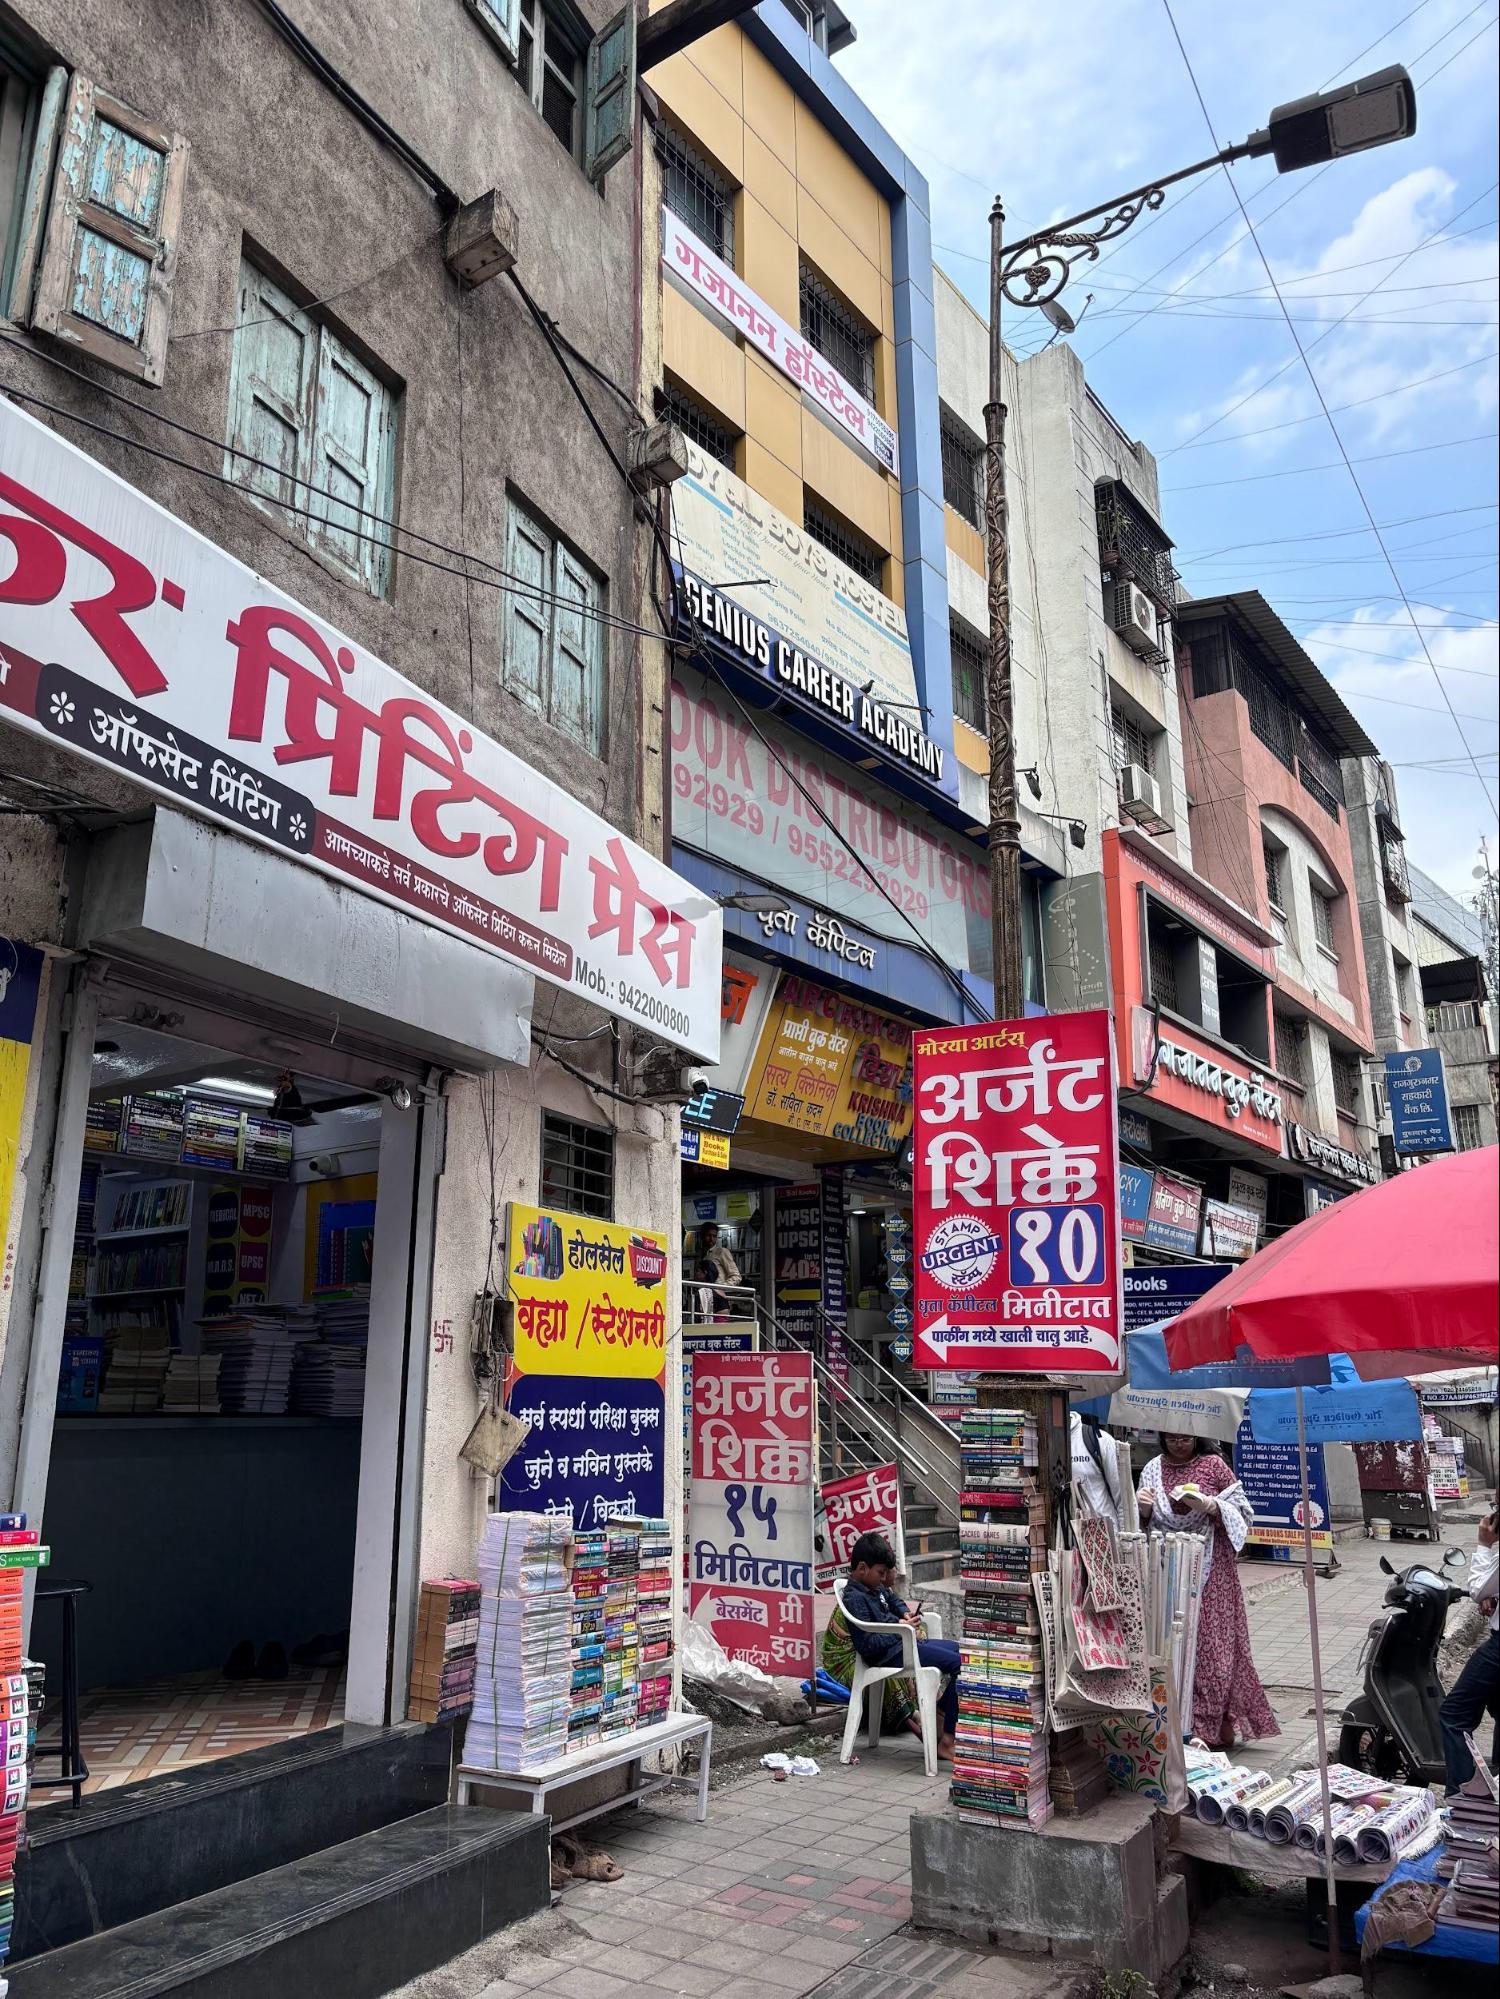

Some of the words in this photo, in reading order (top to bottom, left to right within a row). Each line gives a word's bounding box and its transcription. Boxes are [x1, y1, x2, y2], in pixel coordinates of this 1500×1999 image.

[674, 234, 776, 352] गजानन
[784, 336, 866, 437] हॉस्टेल
[683, 573, 771, 670] GENIUS
[778, 637, 856, 723] CAREER
[861, 695, 945, 780] ACADEMY
[89, 707, 203, 790] ऑफसेट
[209, 758, 282, 830] प्रिंटिंग
[225, 604, 568, 913] प्रिंटिंग
[587, 836, 697, 990] प्रेस
[671, 678, 754, 792] OOK
[766, 734, 993, 919] DISTRIBUTORS
[323, 828, 392, 880] आमच्याकडे
[393, 861, 412, 889] सर्व
[413, 876, 450, 906] प्रकारचे
[453, 894, 489, 929] ऑफसेट
[541, 935, 568, 969] मिळेल
[808, 908, 878, 970] कॅपिटल
[618, 980, 690, 1038] 9422000800
[917, 1037, 968, 1057] मोरया
[971, 1027, 1030, 1051] आर्टस्
[794, 1067, 838, 1102] क्लिनिक
[919, 1037, 1105, 1125] अर्जंट
[1158, 1036, 1225, 1098] गजानन
[1221, 1069, 1251, 1119] बुक
[1401, 1088, 1433, 1101] सहकारी
[780, 1091, 804, 1114] सविता
[847, 1089, 906, 1125] KRISHNA
[855, 1111, 890, 1137] BOOK
[924, 1123, 1101, 1210] शिक्के
[242, 1203, 271, 1220] MPSC
[776, 1207, 821, 1228] MPSC
[568, 1229, 625, 1274] होलसेल
[777, 1230, 820, 1249] UPSC
[921, 1234, 1001, 1270] URGENT
[934, 1220, 982, 1247] STAMP
[1015, 1208, 1098, 1284] १०
[240, 1255, 265, 1269] UPSC
[636, 1254, 663, 1275] DISCOUNT
[1123, 1276, 1168, 1293] Books
[518, 1296, 569, 1348] वह्या
[1001, 1287, 1112, 1320] मिनीटात
[707, 1339, 722, 1351] बुक
[723, 1335, 741, 1350] सेंटर
[972, 1325, 998, 1343] मध्ये
[1000, 1325, 1033, 1343] खाली
[1036, 1328, 1062, 1346] चालु
[1064, 1326, 1093, 1343] आहे.
[695, 1356, 810, 1420] अर्जंट
[549, 1401, 586, 1431] स्पर्धा
[590, 1401, 627, 1432] परिक्षा
[630, 1407, 660, 1436] बुक्स
[525, 1450, 553, 1490] जुने
[558, 1456, 570, 1478] व
[573, 1449, 611, 1477] नविन
[614, 1445, 653, 1483] पुस्तके
[699, 1417, 811, 1483] शिक्के
[723, 1483, 778, 1541] १५
[825, 1472, 898, 1524] अर्जंट
[693, 1539, 813, 1593] मिनिटात
[817, 1567, 838, 1580] खाली
[715, 1596, 765, 1623] बेसमेंट
[770, 1627, 812, 1664] इंक
